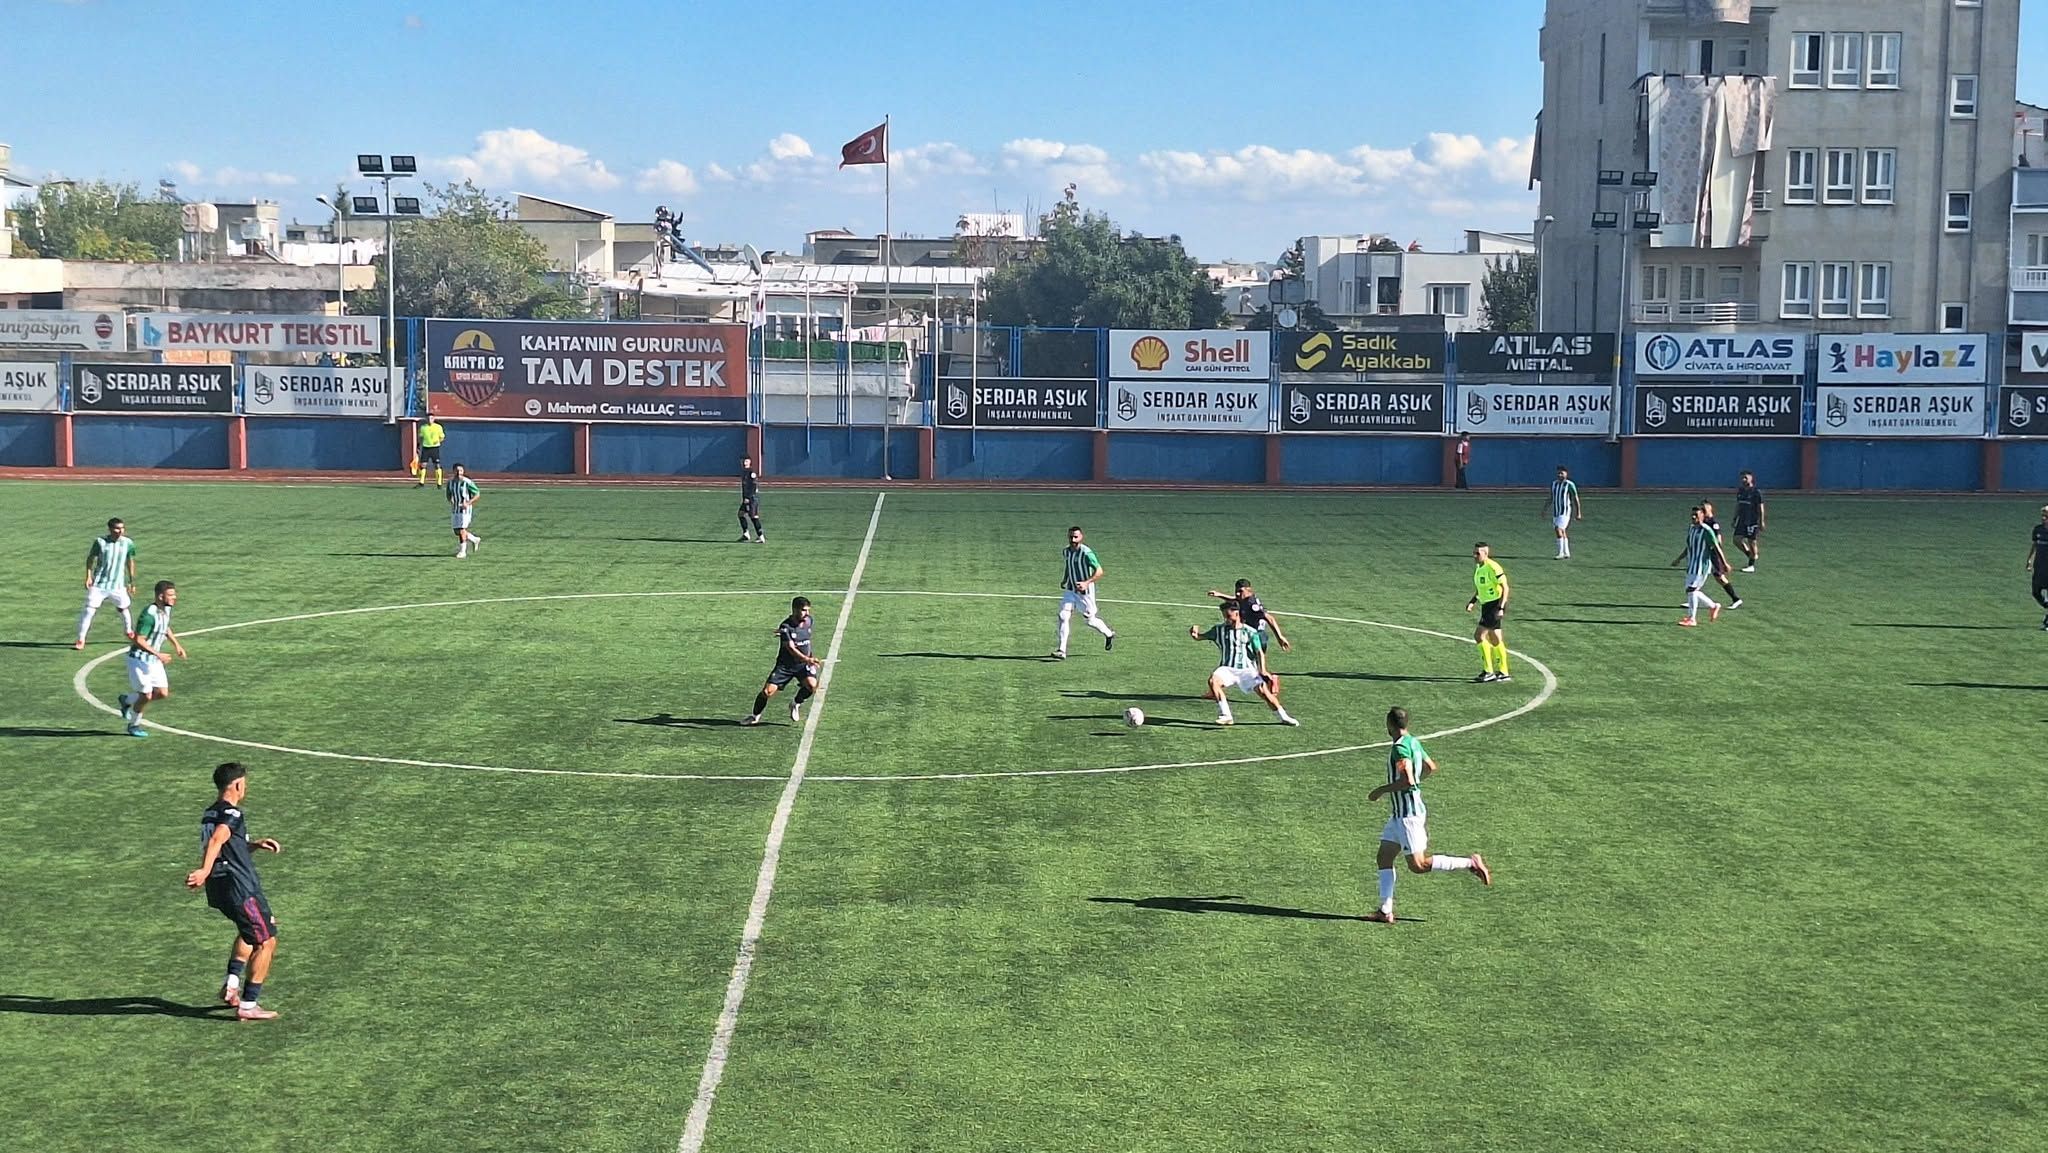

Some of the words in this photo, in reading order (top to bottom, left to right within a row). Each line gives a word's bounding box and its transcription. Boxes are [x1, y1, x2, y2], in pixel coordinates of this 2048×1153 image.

[168, 321, 274, 344] BAYKURT
[1341, 334, 1397, 350] Sadık
[521, 335, 617, 352] KAHTA'NIN
[622, 336, 724, 353] GURURUNA
[1184, 339, 1249, 362] Shell
[1489, 335, 1592, 355] ATLAS
[1685, 338, 1794, 358] ATLAS
[444, 355, 486, 369] KAHTA
[488, 356, 505, 370] 02
[1341, 353, 1431, 371] Ayakkabı
[1506, 358, 1573, 371] METAL
[1685, 360, 1724, 371] CİVATA
[1736, 362, 1792, 371] HIRDAVAT
[1854, 344, 1977, 374] HaylazZ
[4, 371, 47, 390] AŞUK
[521, 357, 592, 385] TAM
[603, 358, 726, 387] DESTEK
[106, 372, 172, 391] SERDAR
[177, 373, 222, 394] AŞUK
[280, 375, 344, 393] SERDAR
[975, 387, 1038, 406] SERDAR
[1043, 388, 1088, 409] AŞUK
[1143, 391, 1207, 409] SERDAR
[1215, 392, 1258, 412] AŞUK
[1316, 393, 1381, 411] SERDAR
[1387, 393, 1432, 414] AŞUK
[1493, 394, 1559, 411] SERDAR
[1566, 395, 1611, 415] AŞUK
[1671, 396, 1739, 414] SERDAR
[1745, 396, 1792, 417] AŞUK
[1853, 396, 1921, 414] SERDAR
[1928, 396, 1974, 416] AŞUK
[600, 402, 624, 415] Can
[627, 403, 675, 417] HALLAÇ
[987, 408, 1015, 420] İNŞAAT
[1157, 412, 1185, 423] İNŞAAT
[1330, 413, 1358, 425] İNŞAAT
[1507, 415, 1536, 426] İNŞAAT
